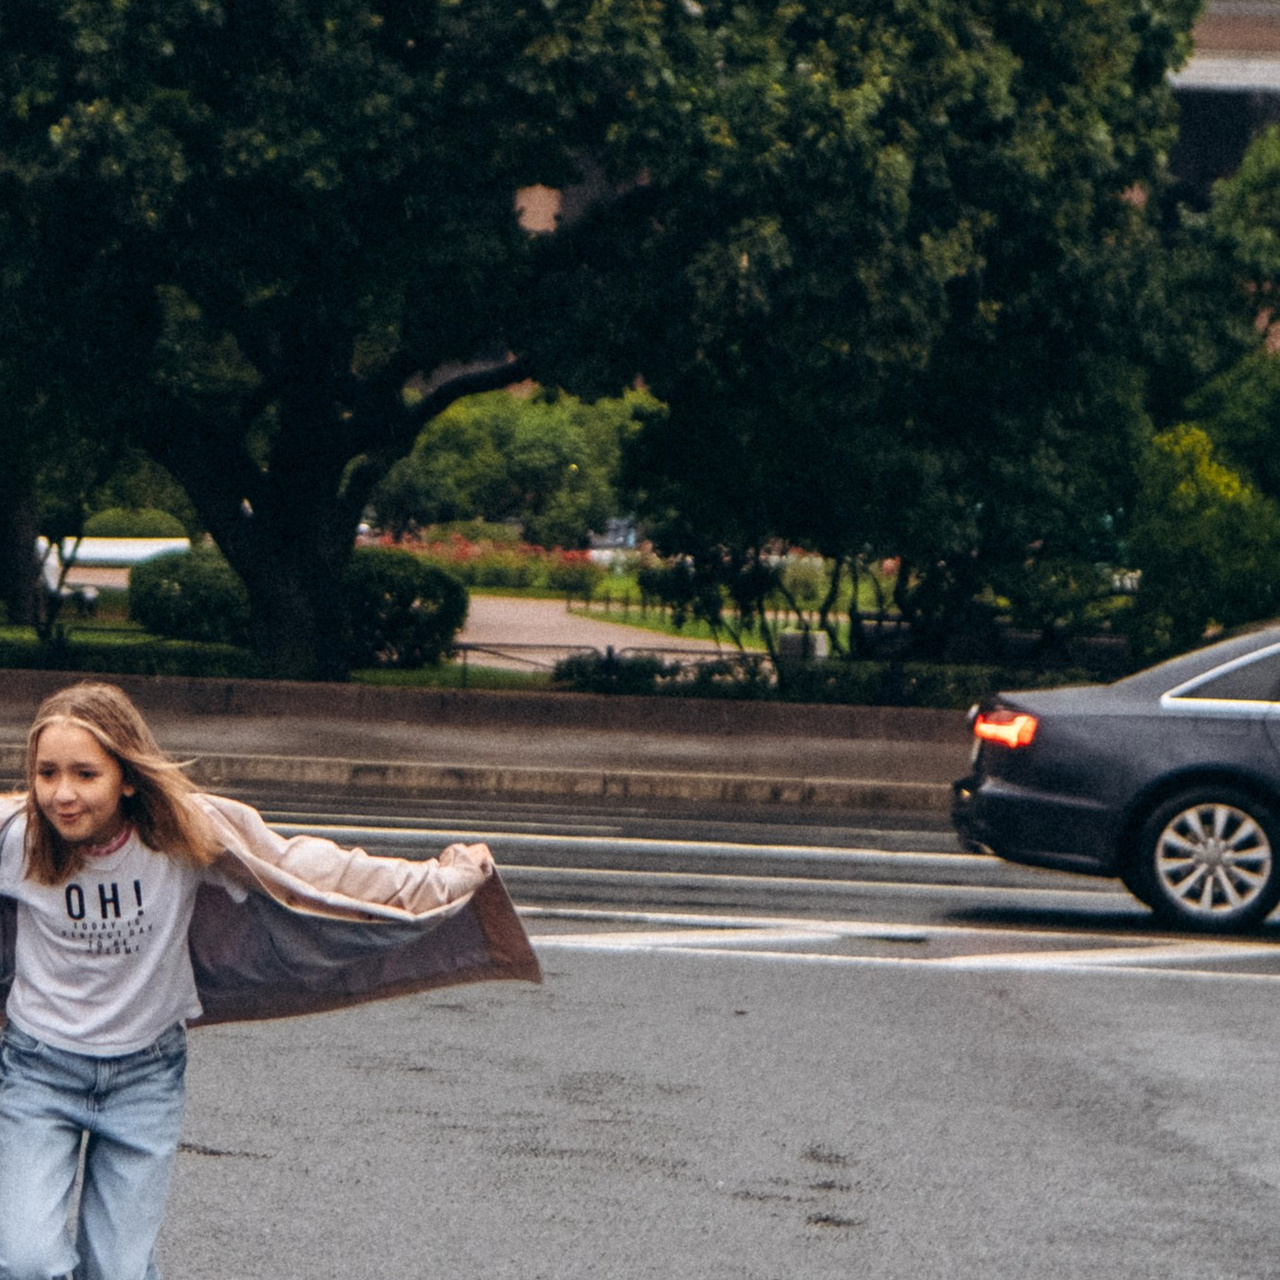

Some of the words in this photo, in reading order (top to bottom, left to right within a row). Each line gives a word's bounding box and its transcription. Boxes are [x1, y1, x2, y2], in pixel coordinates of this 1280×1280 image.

[65, 879, 144, 920] OH!
[73, 921, 116, 931] TODAY
[129, 924, 153, 937] DAY
